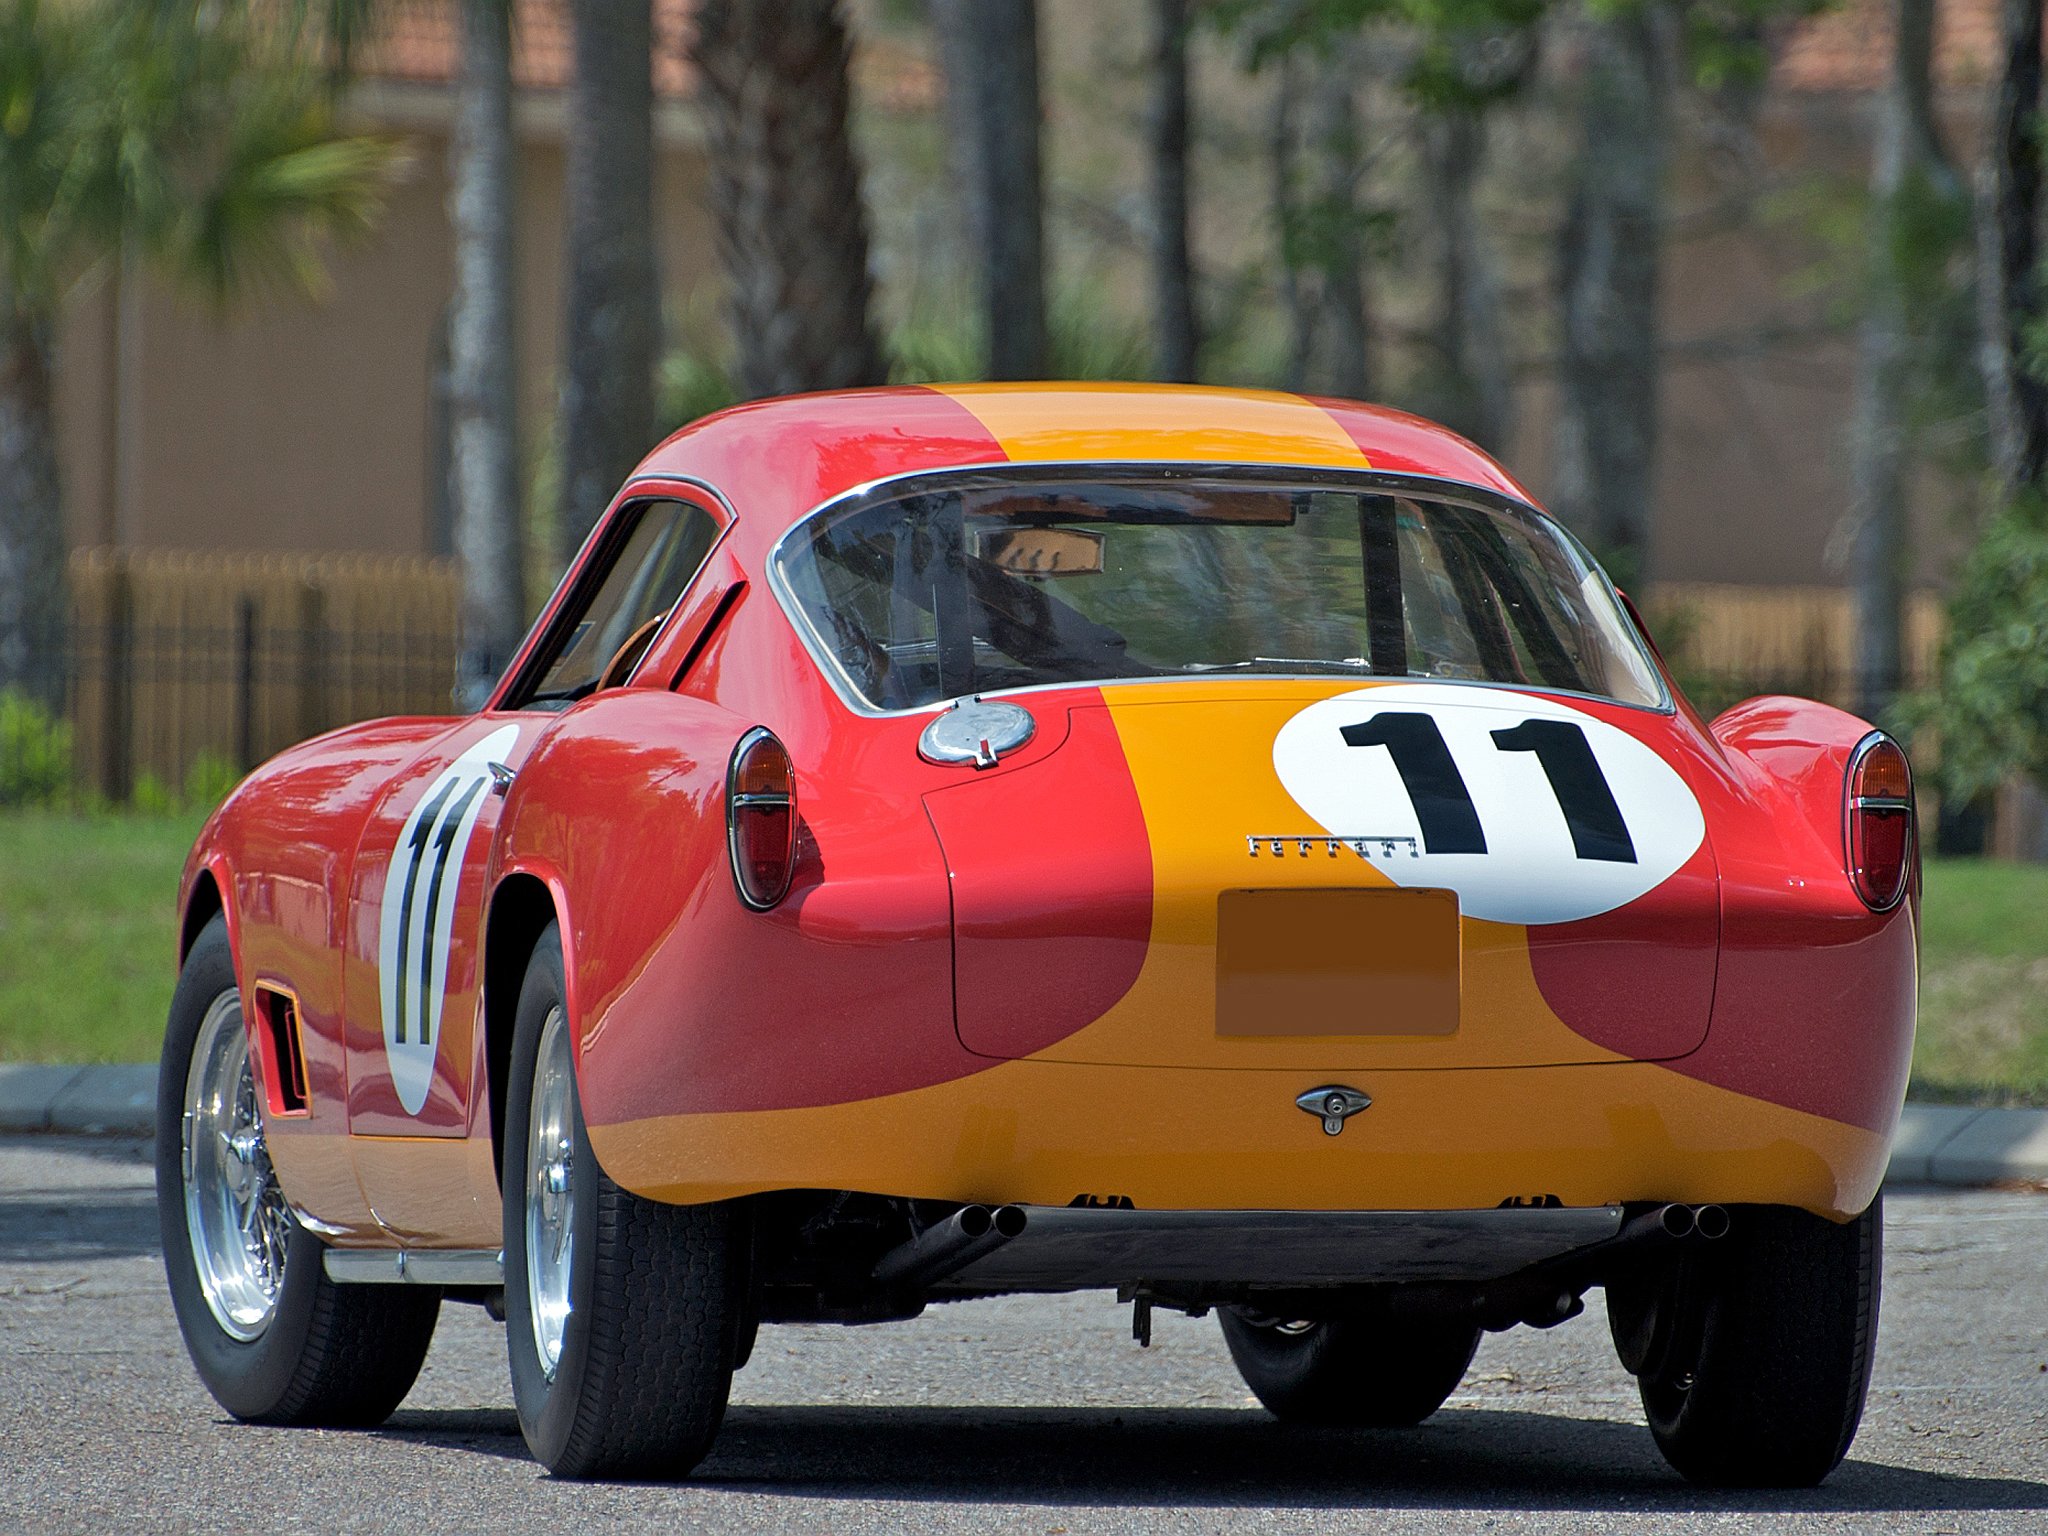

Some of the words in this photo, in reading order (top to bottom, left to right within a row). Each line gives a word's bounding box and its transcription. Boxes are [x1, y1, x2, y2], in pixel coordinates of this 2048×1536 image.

[1246, 835, 1419, 856] Ferrari
[1339, 712, 1638, 864] 11
[395, 776, 487, 1045] 11
